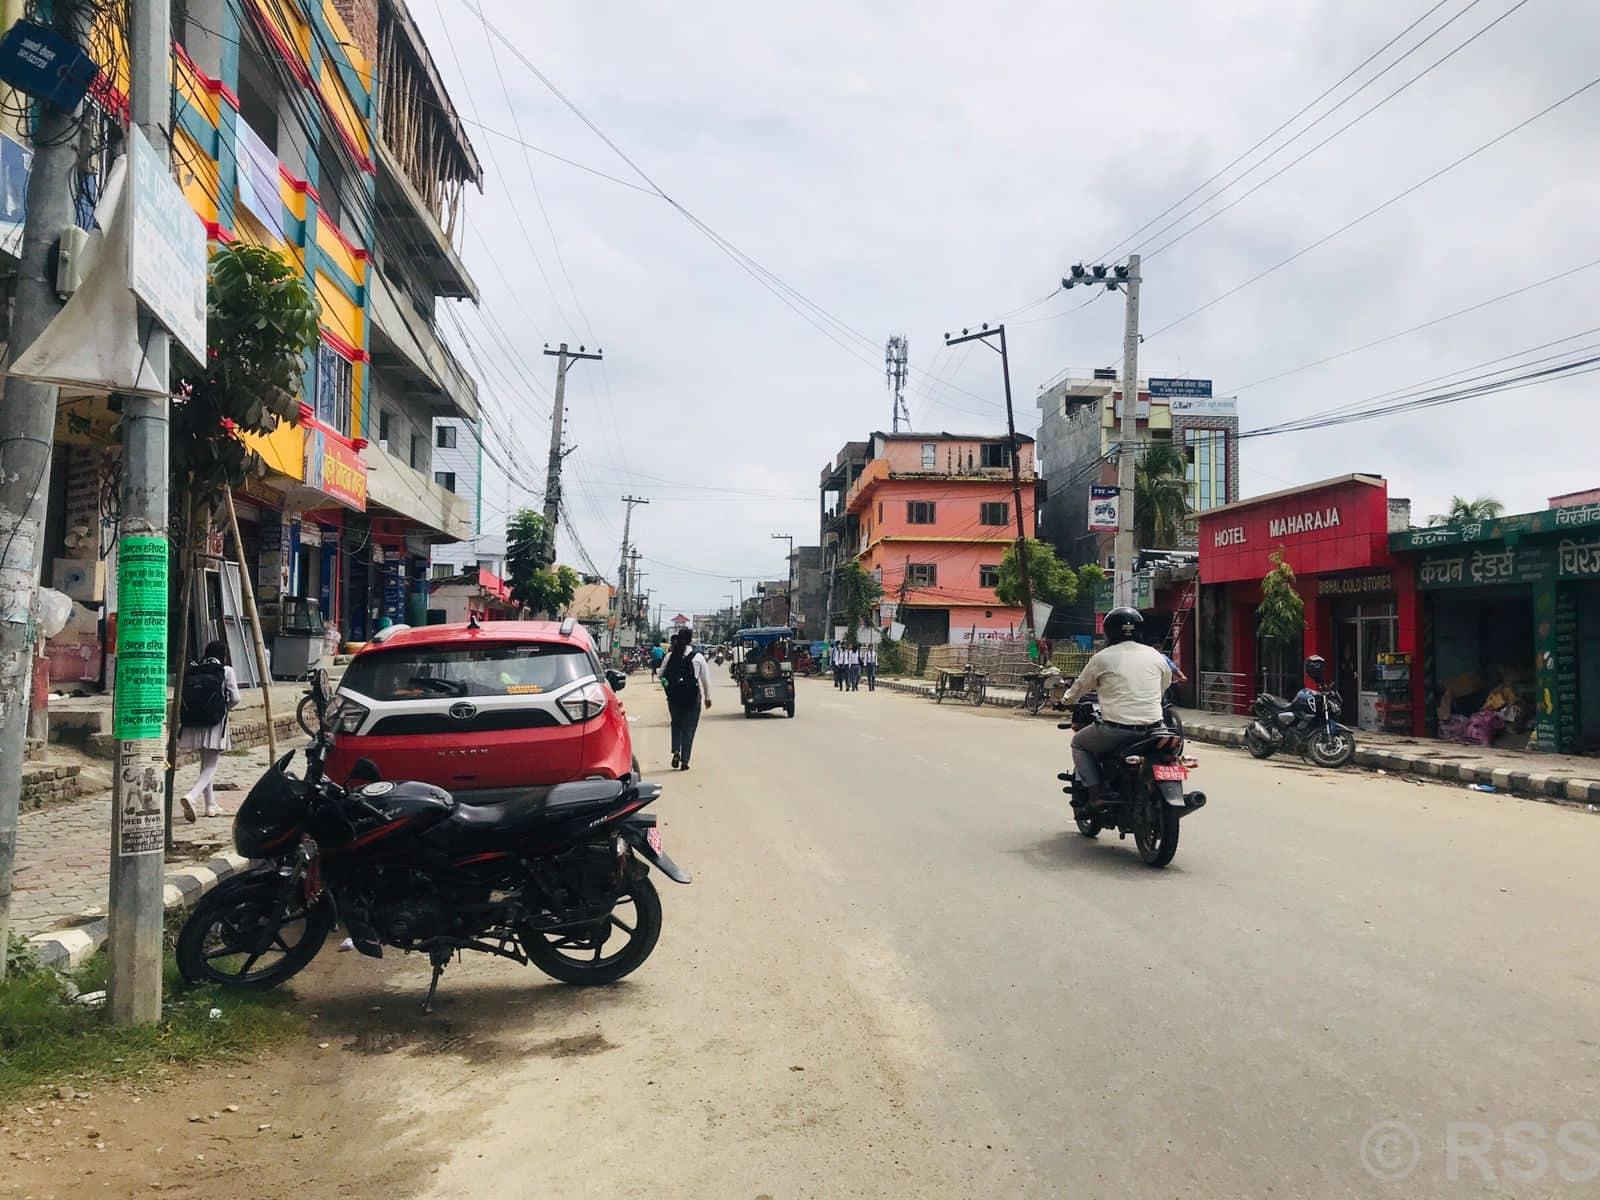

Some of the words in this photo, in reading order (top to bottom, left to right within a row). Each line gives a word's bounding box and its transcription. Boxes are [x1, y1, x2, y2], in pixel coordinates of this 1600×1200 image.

[1214, 526, 1247, 547] HOTEL
[1269, 507, 1340, 538] MAHARAJA
[1420, 554, 1464, 583] कंचन
